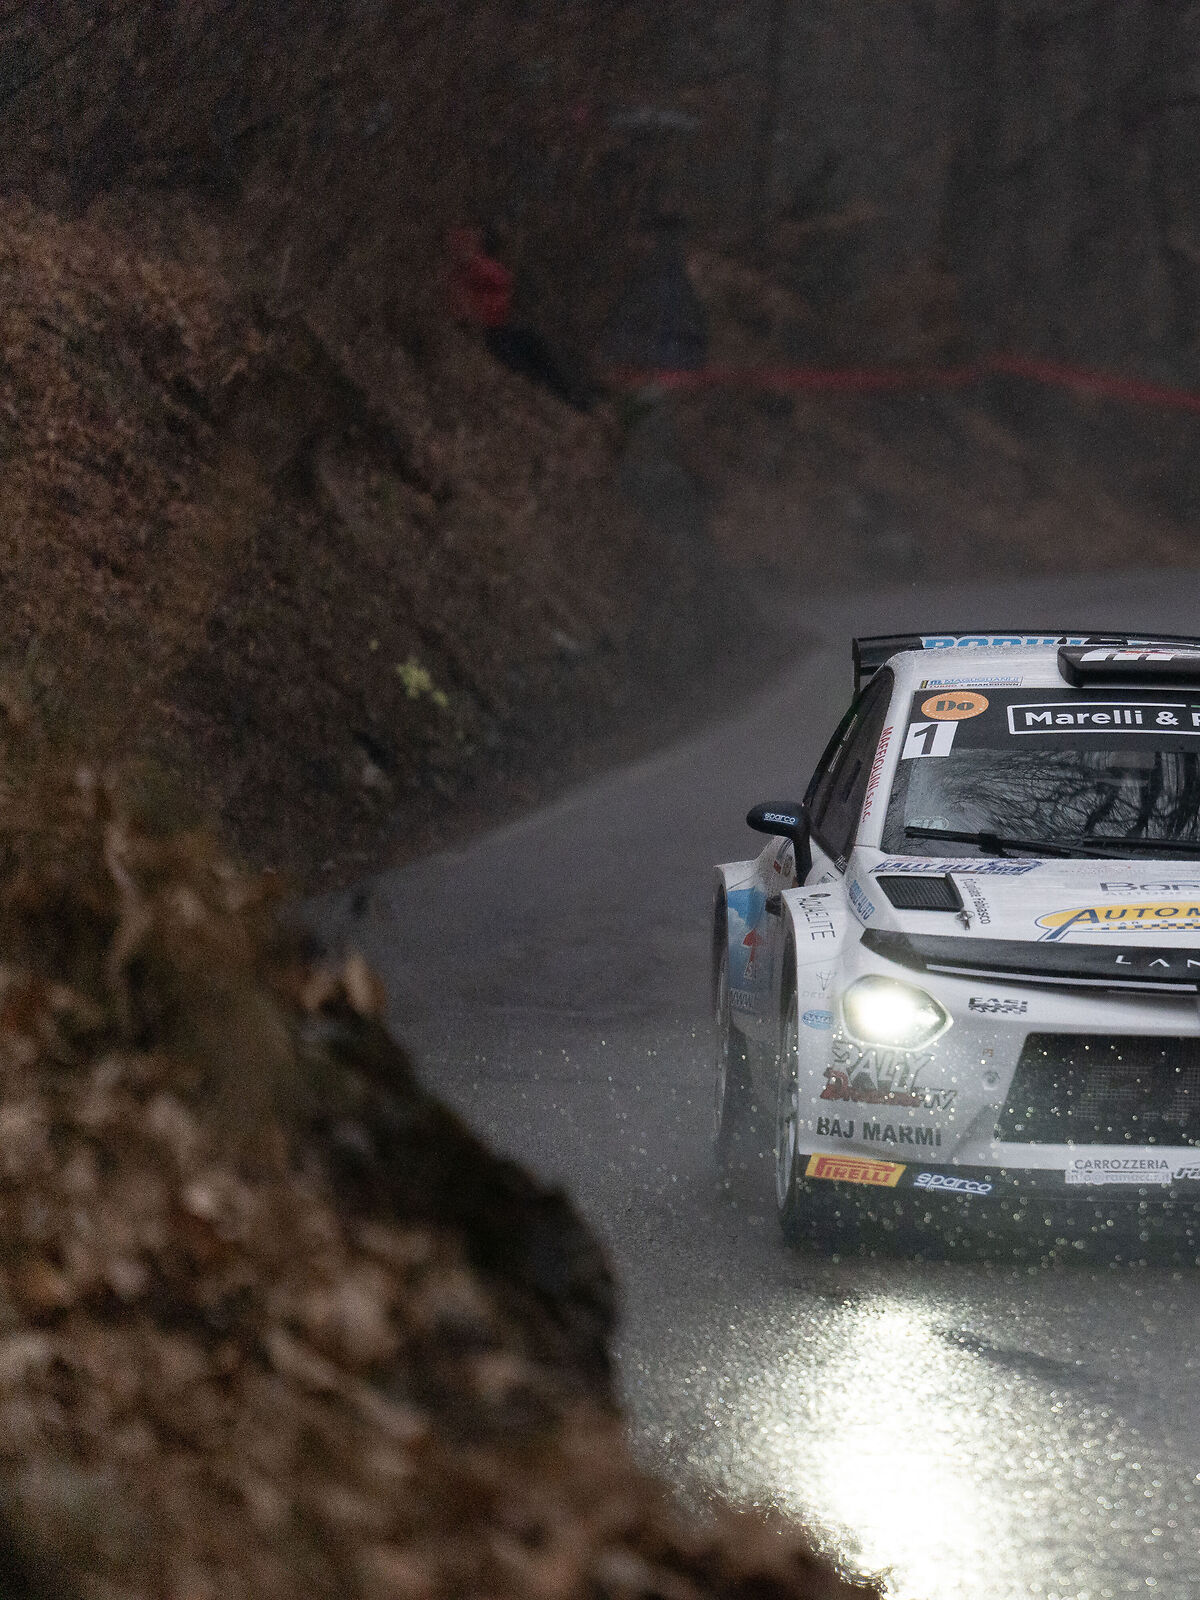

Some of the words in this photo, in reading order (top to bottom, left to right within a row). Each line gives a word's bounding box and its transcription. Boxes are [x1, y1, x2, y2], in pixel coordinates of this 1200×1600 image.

[936, 701, 975, 711] Do
[1025, 709, 1143, 726] Marelli
[1155, 710, 1179, 726] &
[914, 724, 939, 755] 1
[764, 811, 796, 824] sparco
[816, 1116, 855, 1139] BAJ
[863, 1121, 942, 1146] MARMI
[814, 1156, 898, 1184] PIRELLI
[1074, 1159, 1169, 1170] CARROZZERIA
[915, 1171, 993, 1194] sparco
